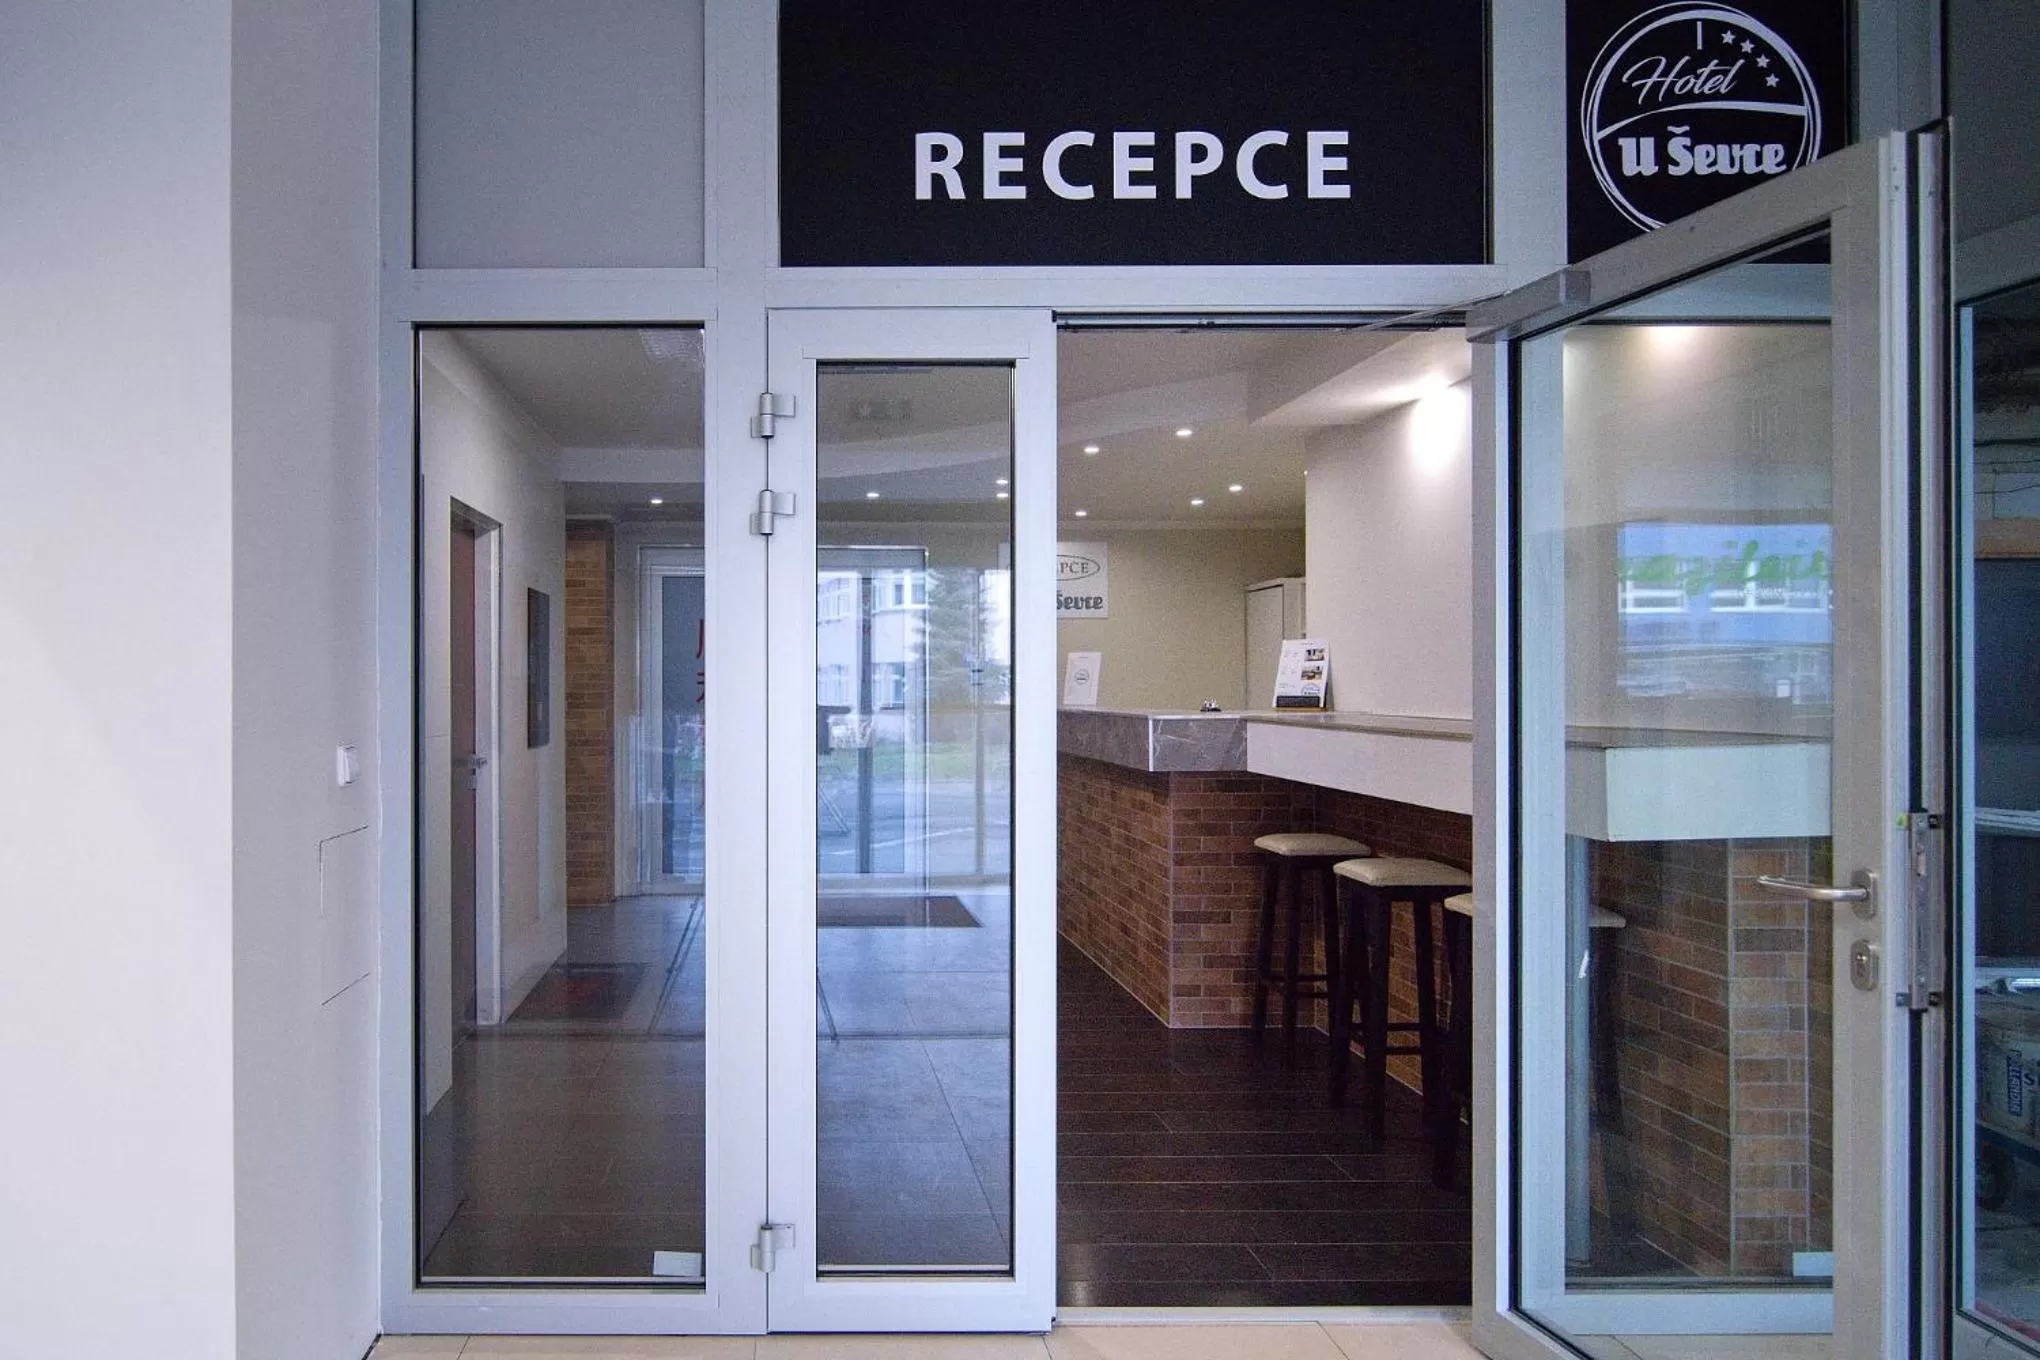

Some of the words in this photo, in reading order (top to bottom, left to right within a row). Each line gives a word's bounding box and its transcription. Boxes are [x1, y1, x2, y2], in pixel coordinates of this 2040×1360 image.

[1622, 56, 1745, 104] Hotel
[915, 130, 1352, 200] RECEPCE
[1057, 562, 1089, 573] PCE
